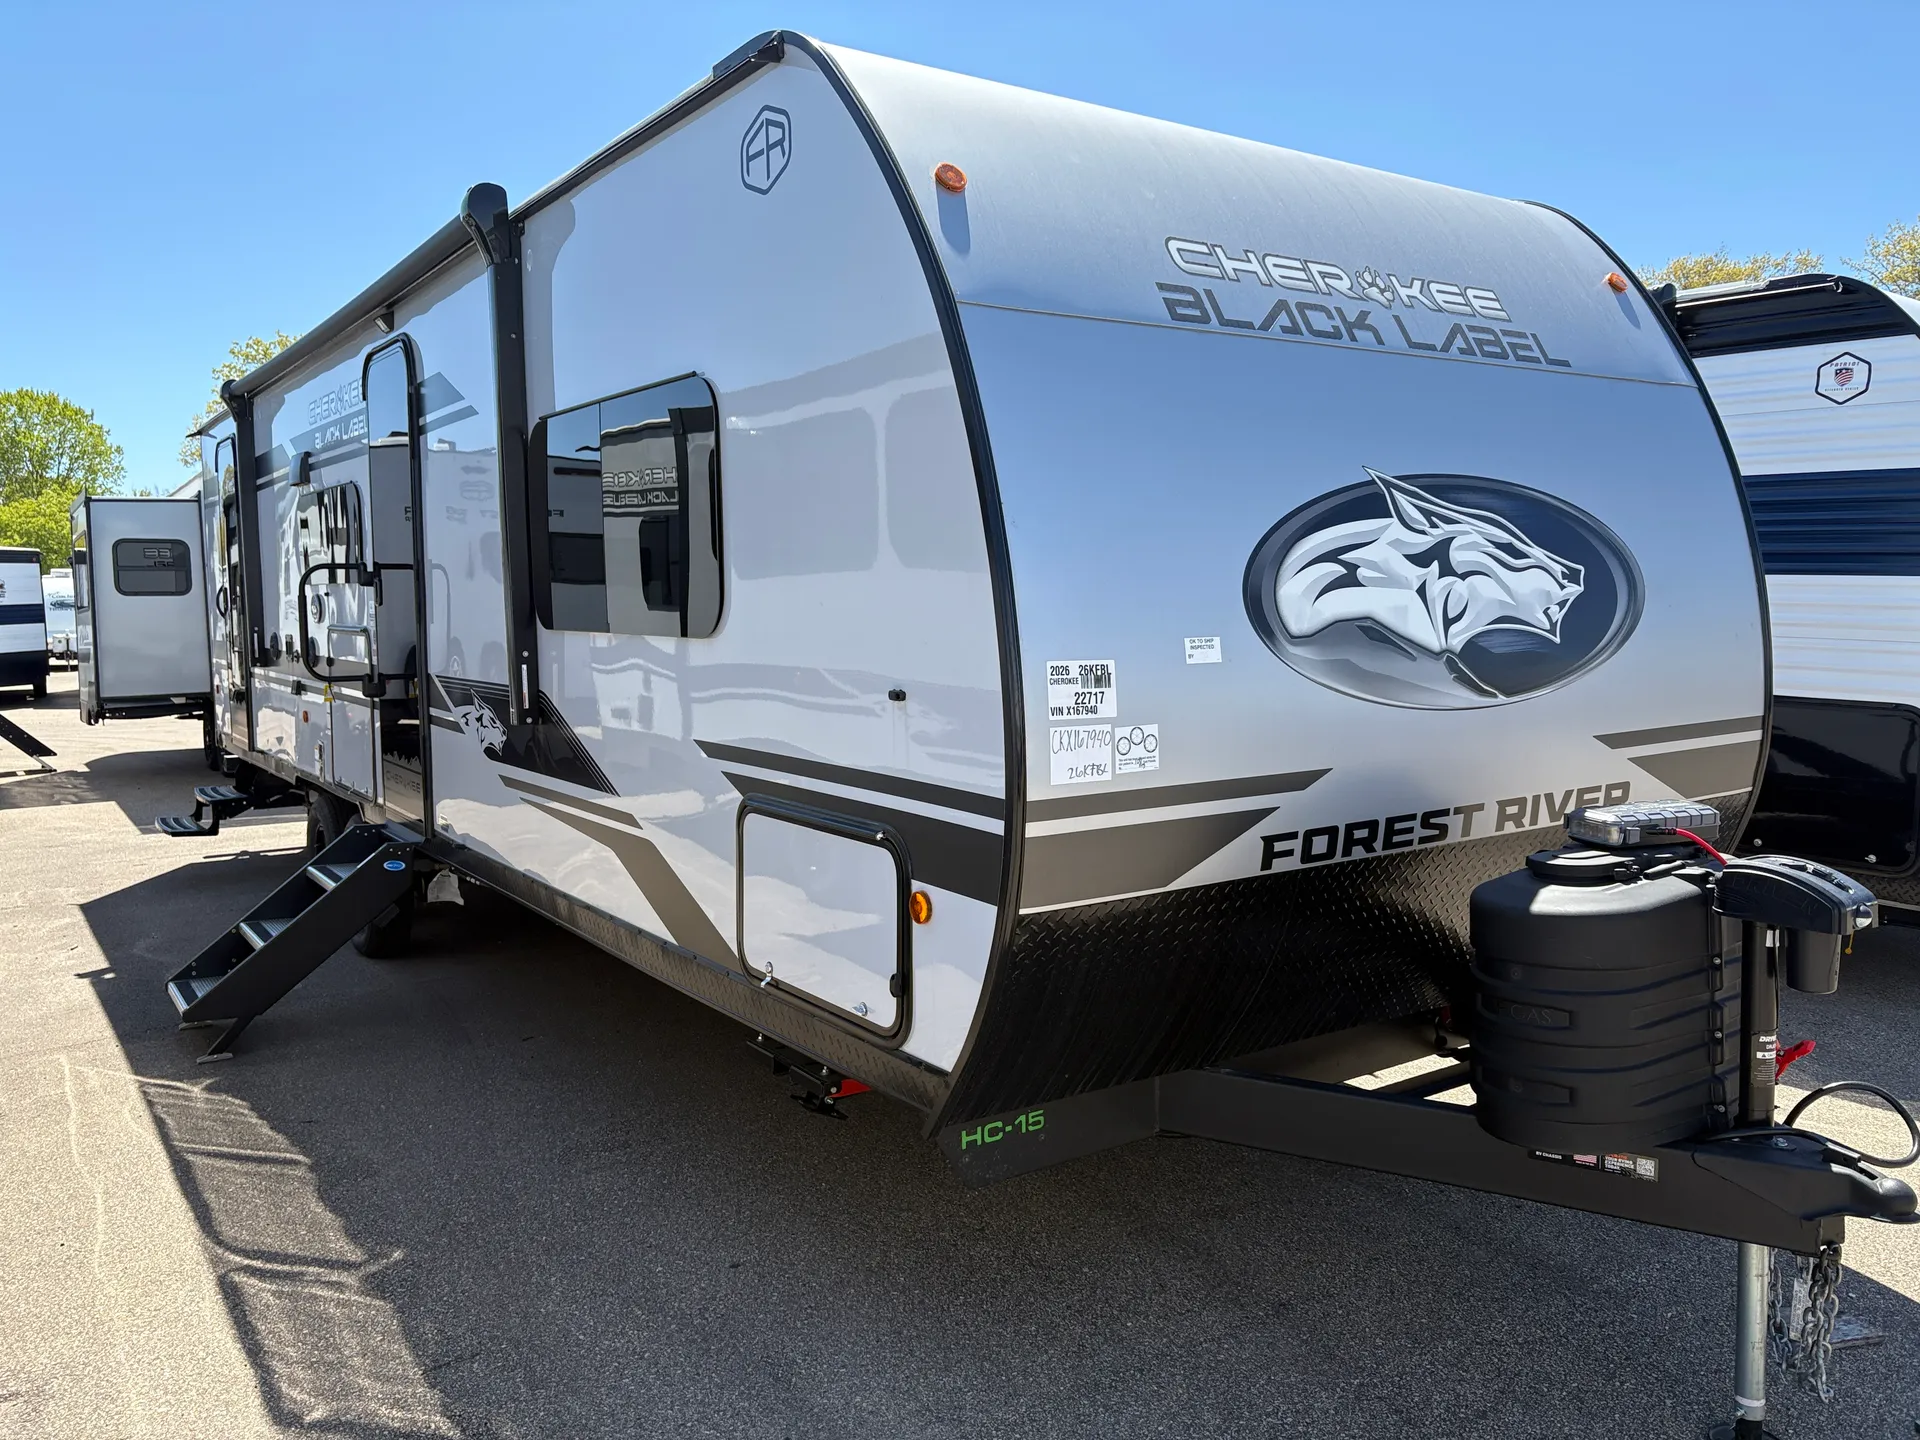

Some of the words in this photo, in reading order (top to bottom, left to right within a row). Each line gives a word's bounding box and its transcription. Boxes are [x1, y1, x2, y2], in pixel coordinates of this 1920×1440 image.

[1154, 281, 1386, 346] BLACK
[1391, 313, 1572, 368] LABEL
[315, 423, 340, 450] BLACK
[342, 414, 368, 441] LABEL
[1049, 677, 1080, 686] CHEROKEE
[1050, 665, 1070, 677] 2026
[1050, 706, 1064, 717] VIN
[1066, 704, 1098, 716] X167940
[1074, 691, 1105, 705] 22717
[1259, 802, 1485, 872] FOREST
[961, 1109, 1045, 1151] HC-15
